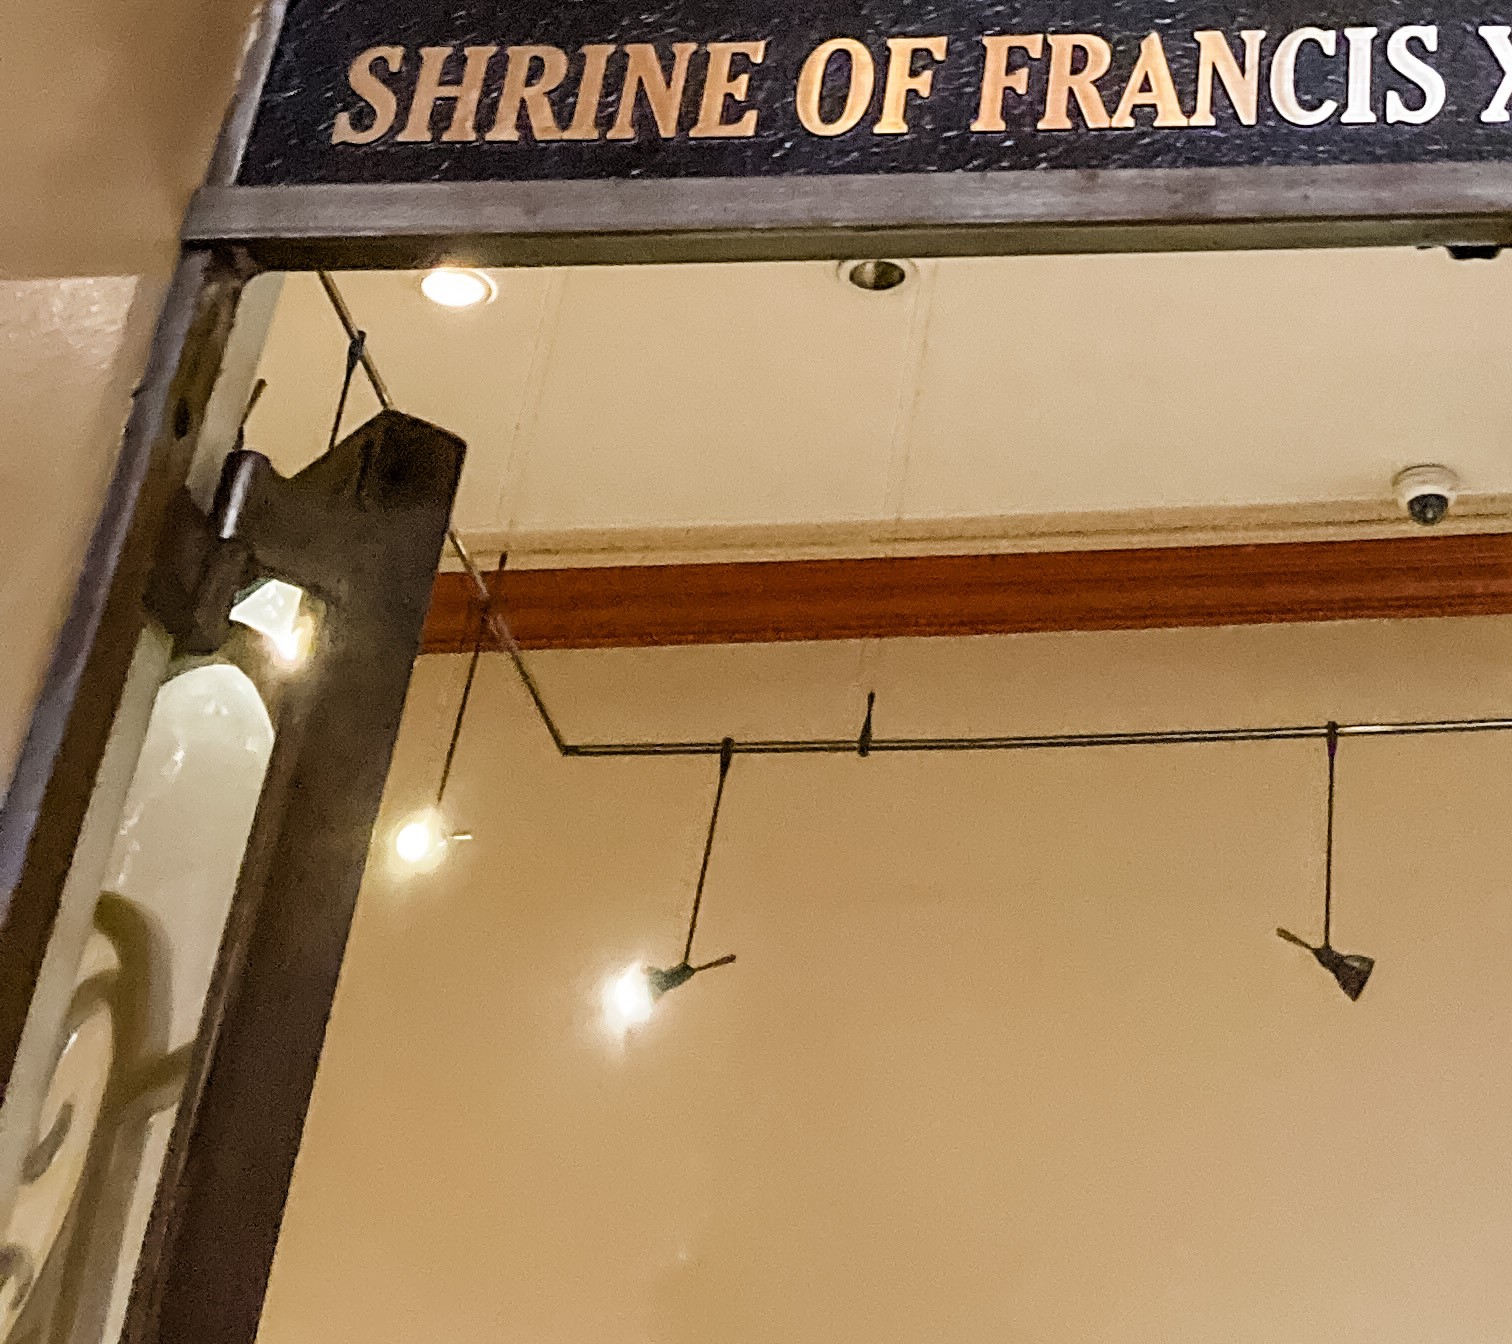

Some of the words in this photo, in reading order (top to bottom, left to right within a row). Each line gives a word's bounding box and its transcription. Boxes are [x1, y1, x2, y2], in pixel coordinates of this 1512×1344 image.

[333, 38, 766, 145] SHRINE
[796, 34, 948, 137] OF
[974, 23, 1446, 133] FRANCIS
